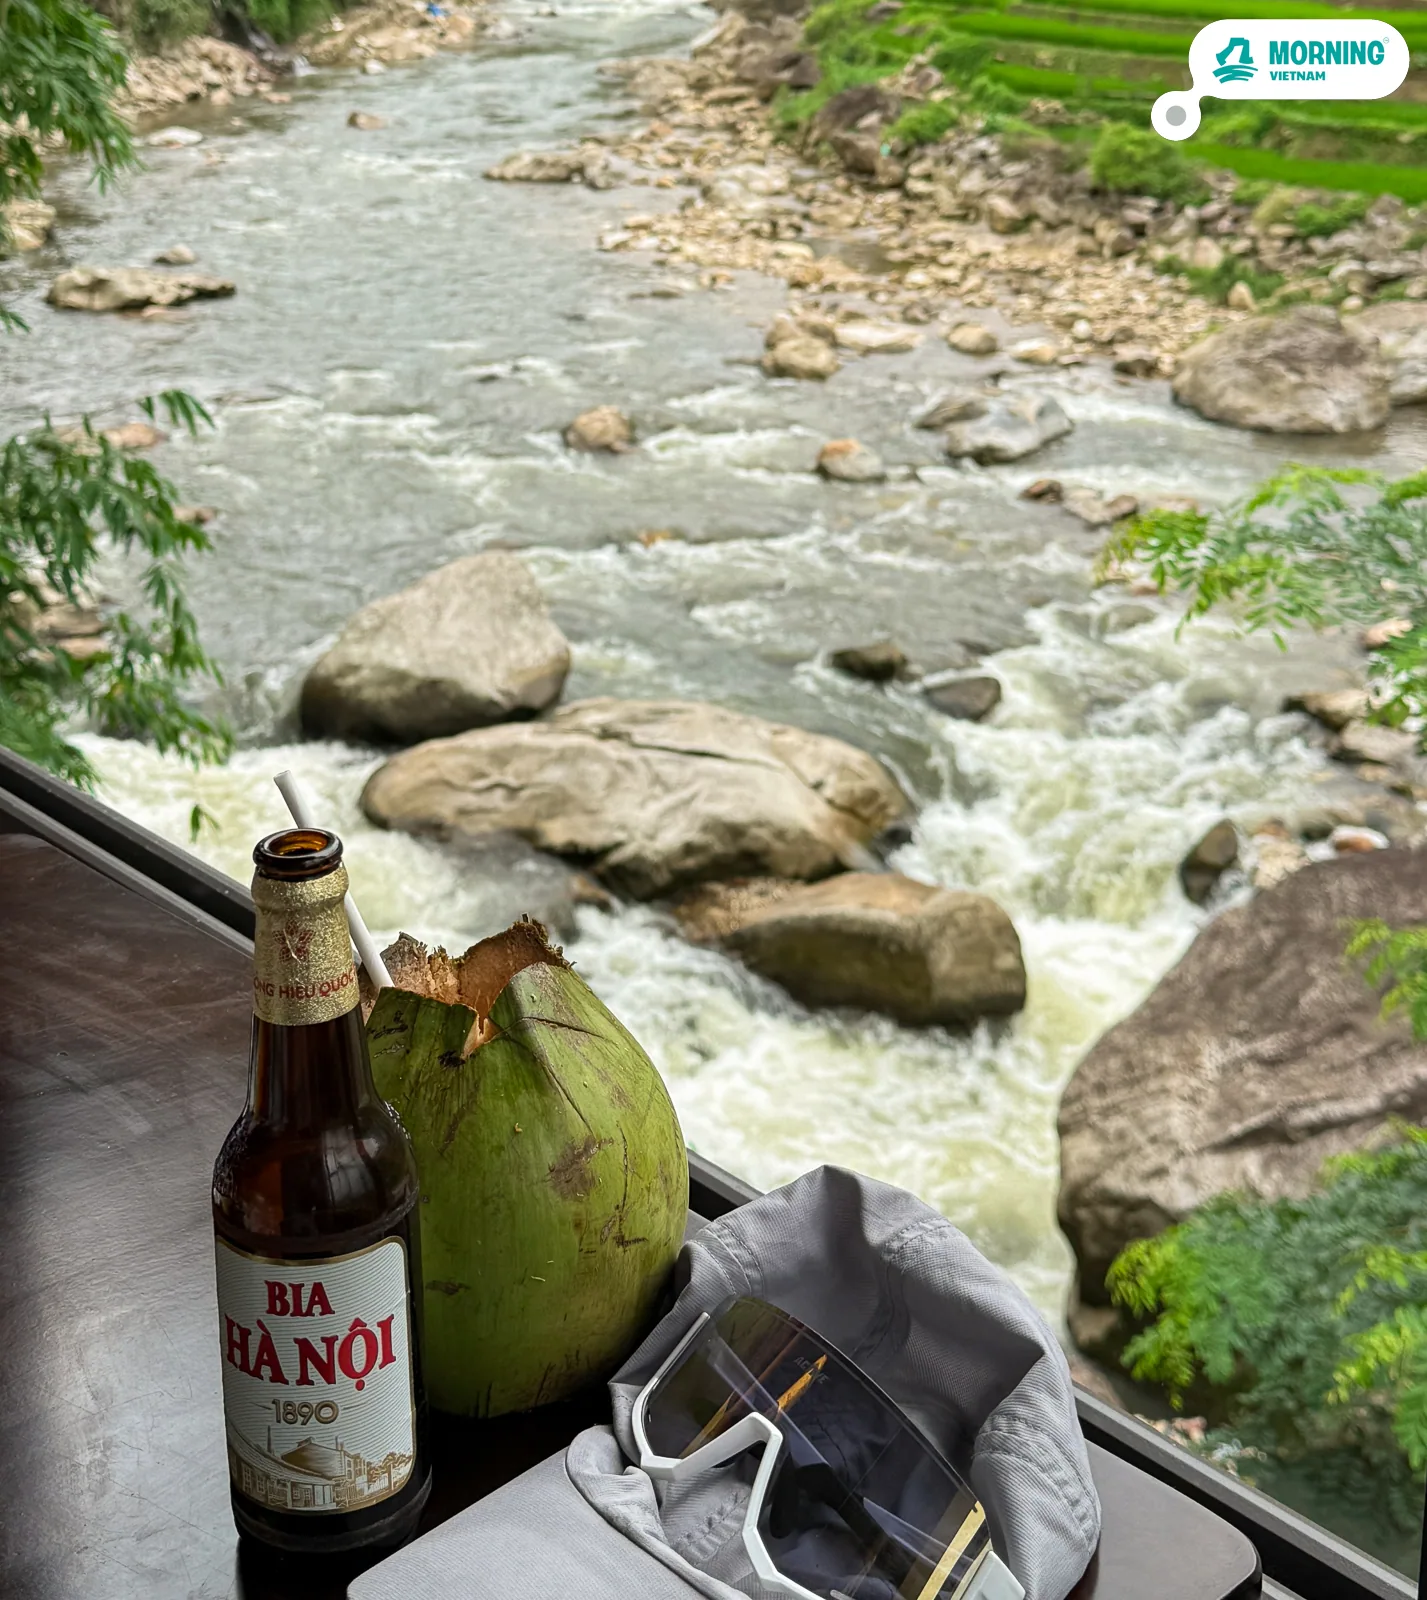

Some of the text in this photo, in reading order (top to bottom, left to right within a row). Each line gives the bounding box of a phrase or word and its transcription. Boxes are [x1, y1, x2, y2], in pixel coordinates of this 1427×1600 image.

[264, 1280, 336, 1317] BIA
[224, 1313, 397, 1391] HÀ NỘI
[271, 1398, 339, 1425] 1890
